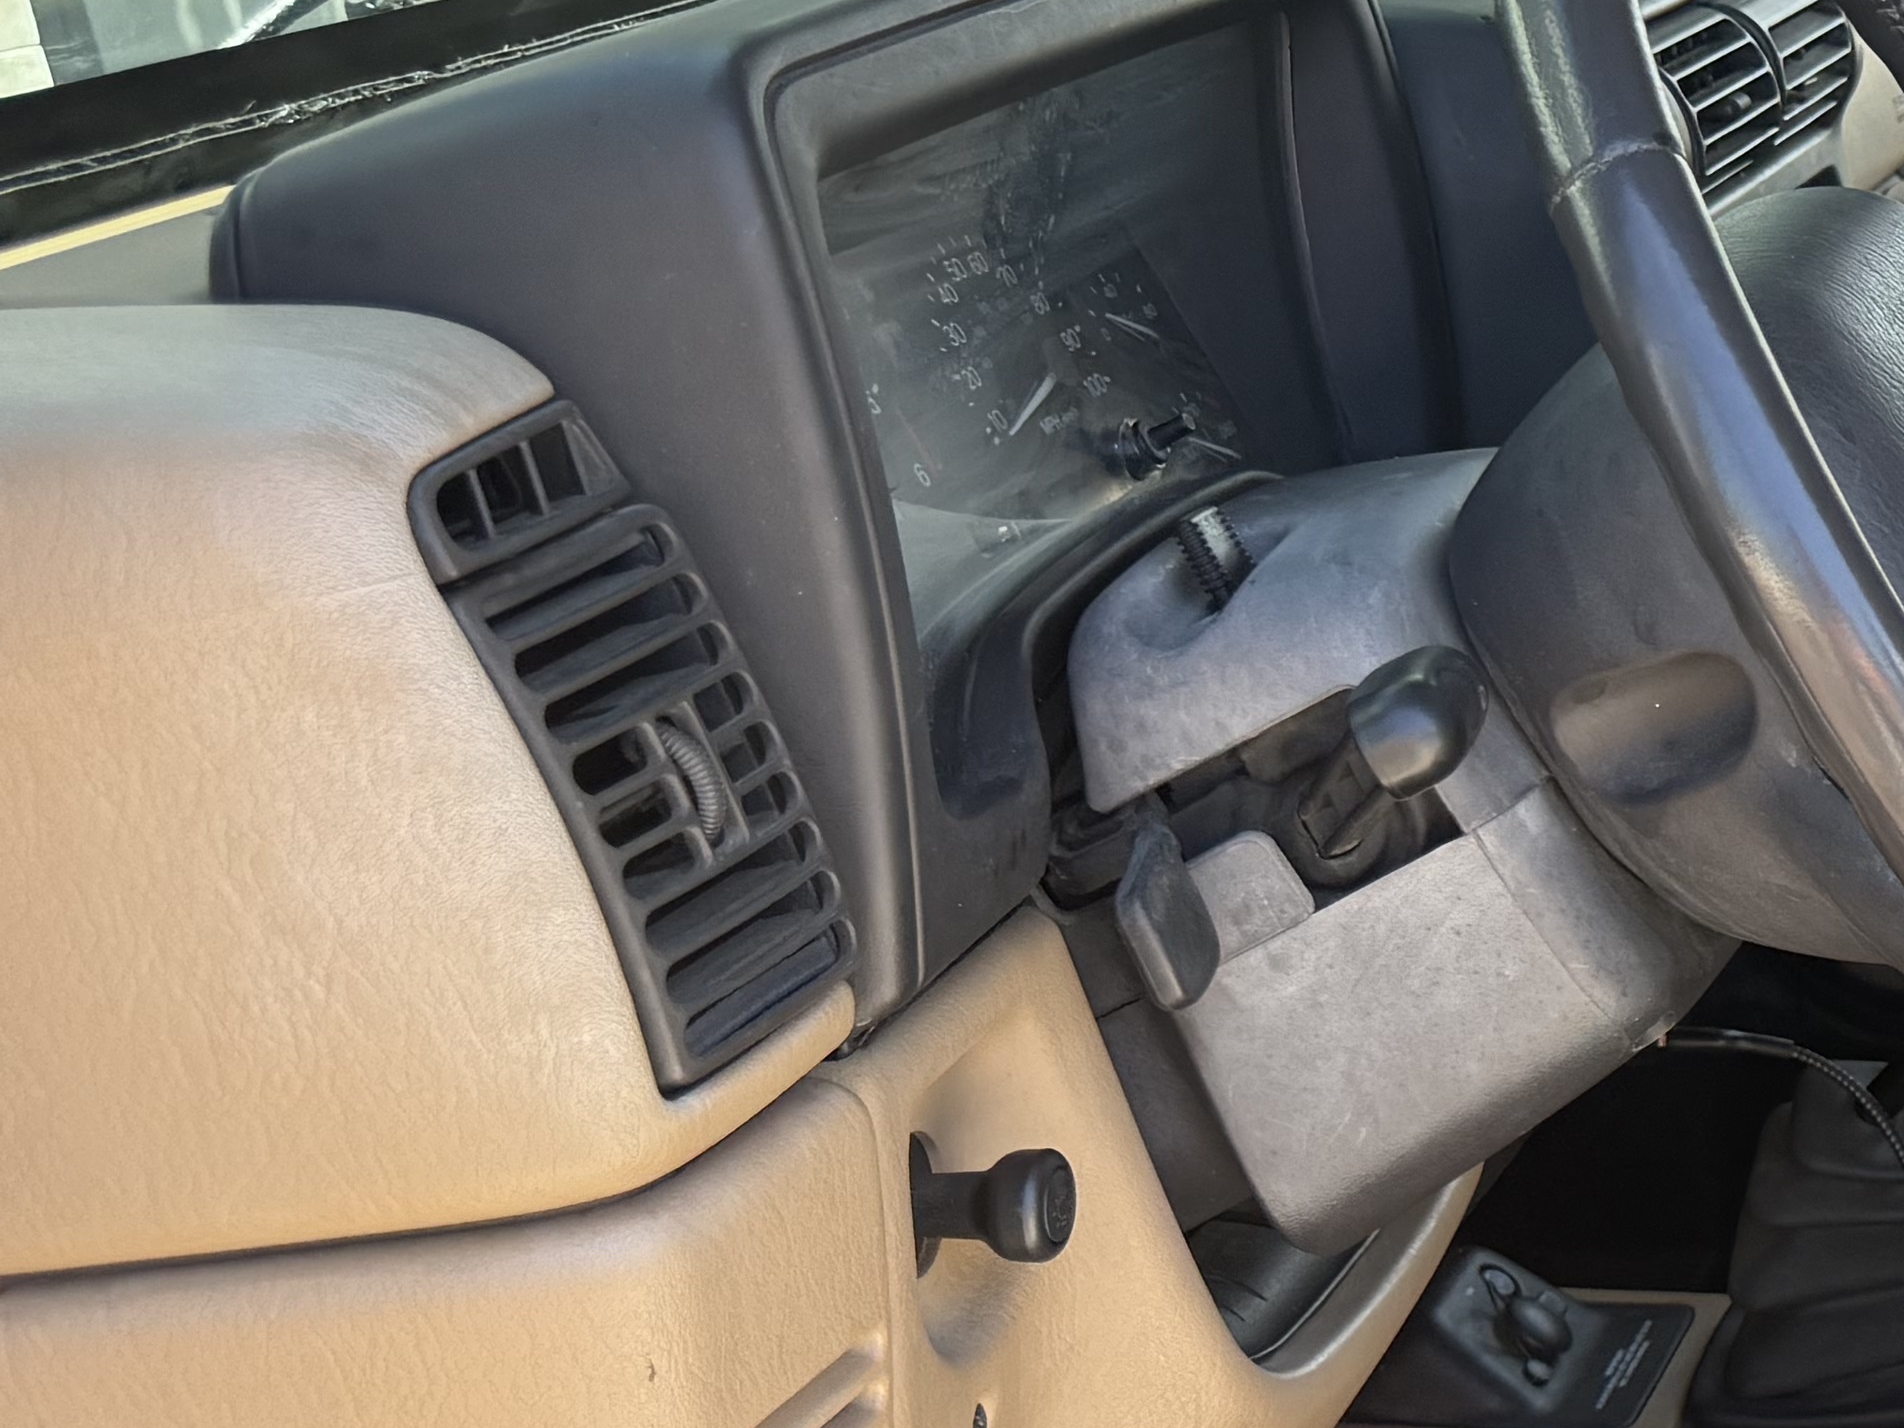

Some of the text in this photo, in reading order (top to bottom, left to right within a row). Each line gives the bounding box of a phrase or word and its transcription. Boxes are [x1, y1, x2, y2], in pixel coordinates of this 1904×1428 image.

[943, 258, 968, 282] 50
[967, 252, 989, 275] 60
[995, 264, 1018, 288] 70
[938, 283, 959, 305] 40
[1029, 291, 1050, 315] 80
[943, 322, 968, 346] 30
[1060, 328, 1081, 351] 90
[961, 366, 982, 390] 20
[1083, 373, 1108, 398] 100
[987, 409, 1008, 431] 10
[913, 463, 931, 487] 6
